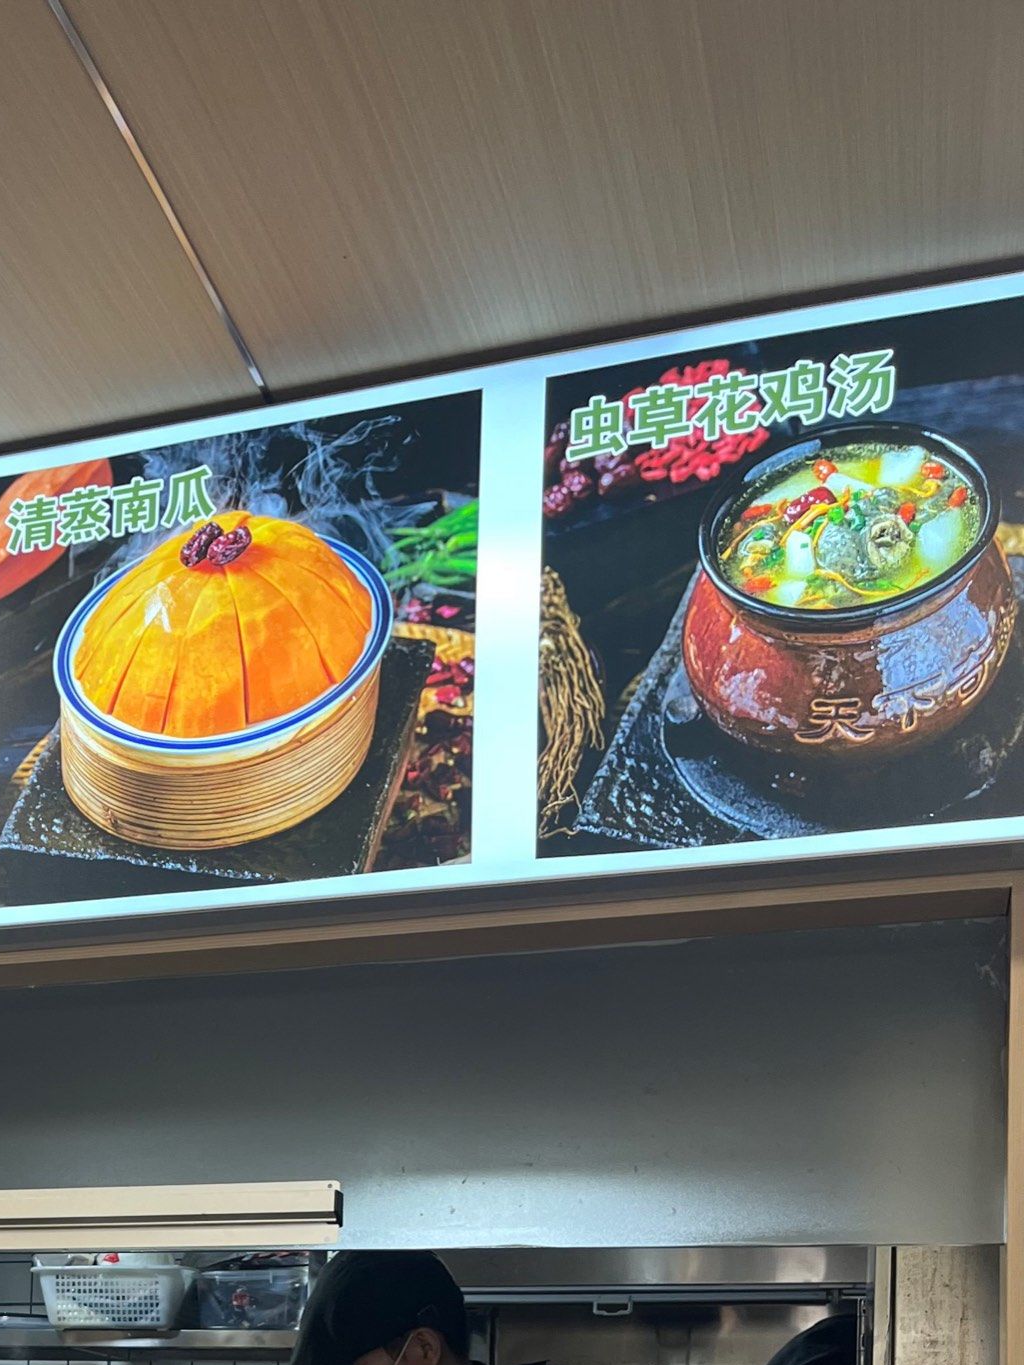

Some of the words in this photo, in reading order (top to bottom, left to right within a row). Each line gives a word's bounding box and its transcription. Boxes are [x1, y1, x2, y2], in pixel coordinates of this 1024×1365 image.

[565, 349, 896, 461] 虫草花鸡汤
[5, 465, 216, 555] 清蒸南瓜
